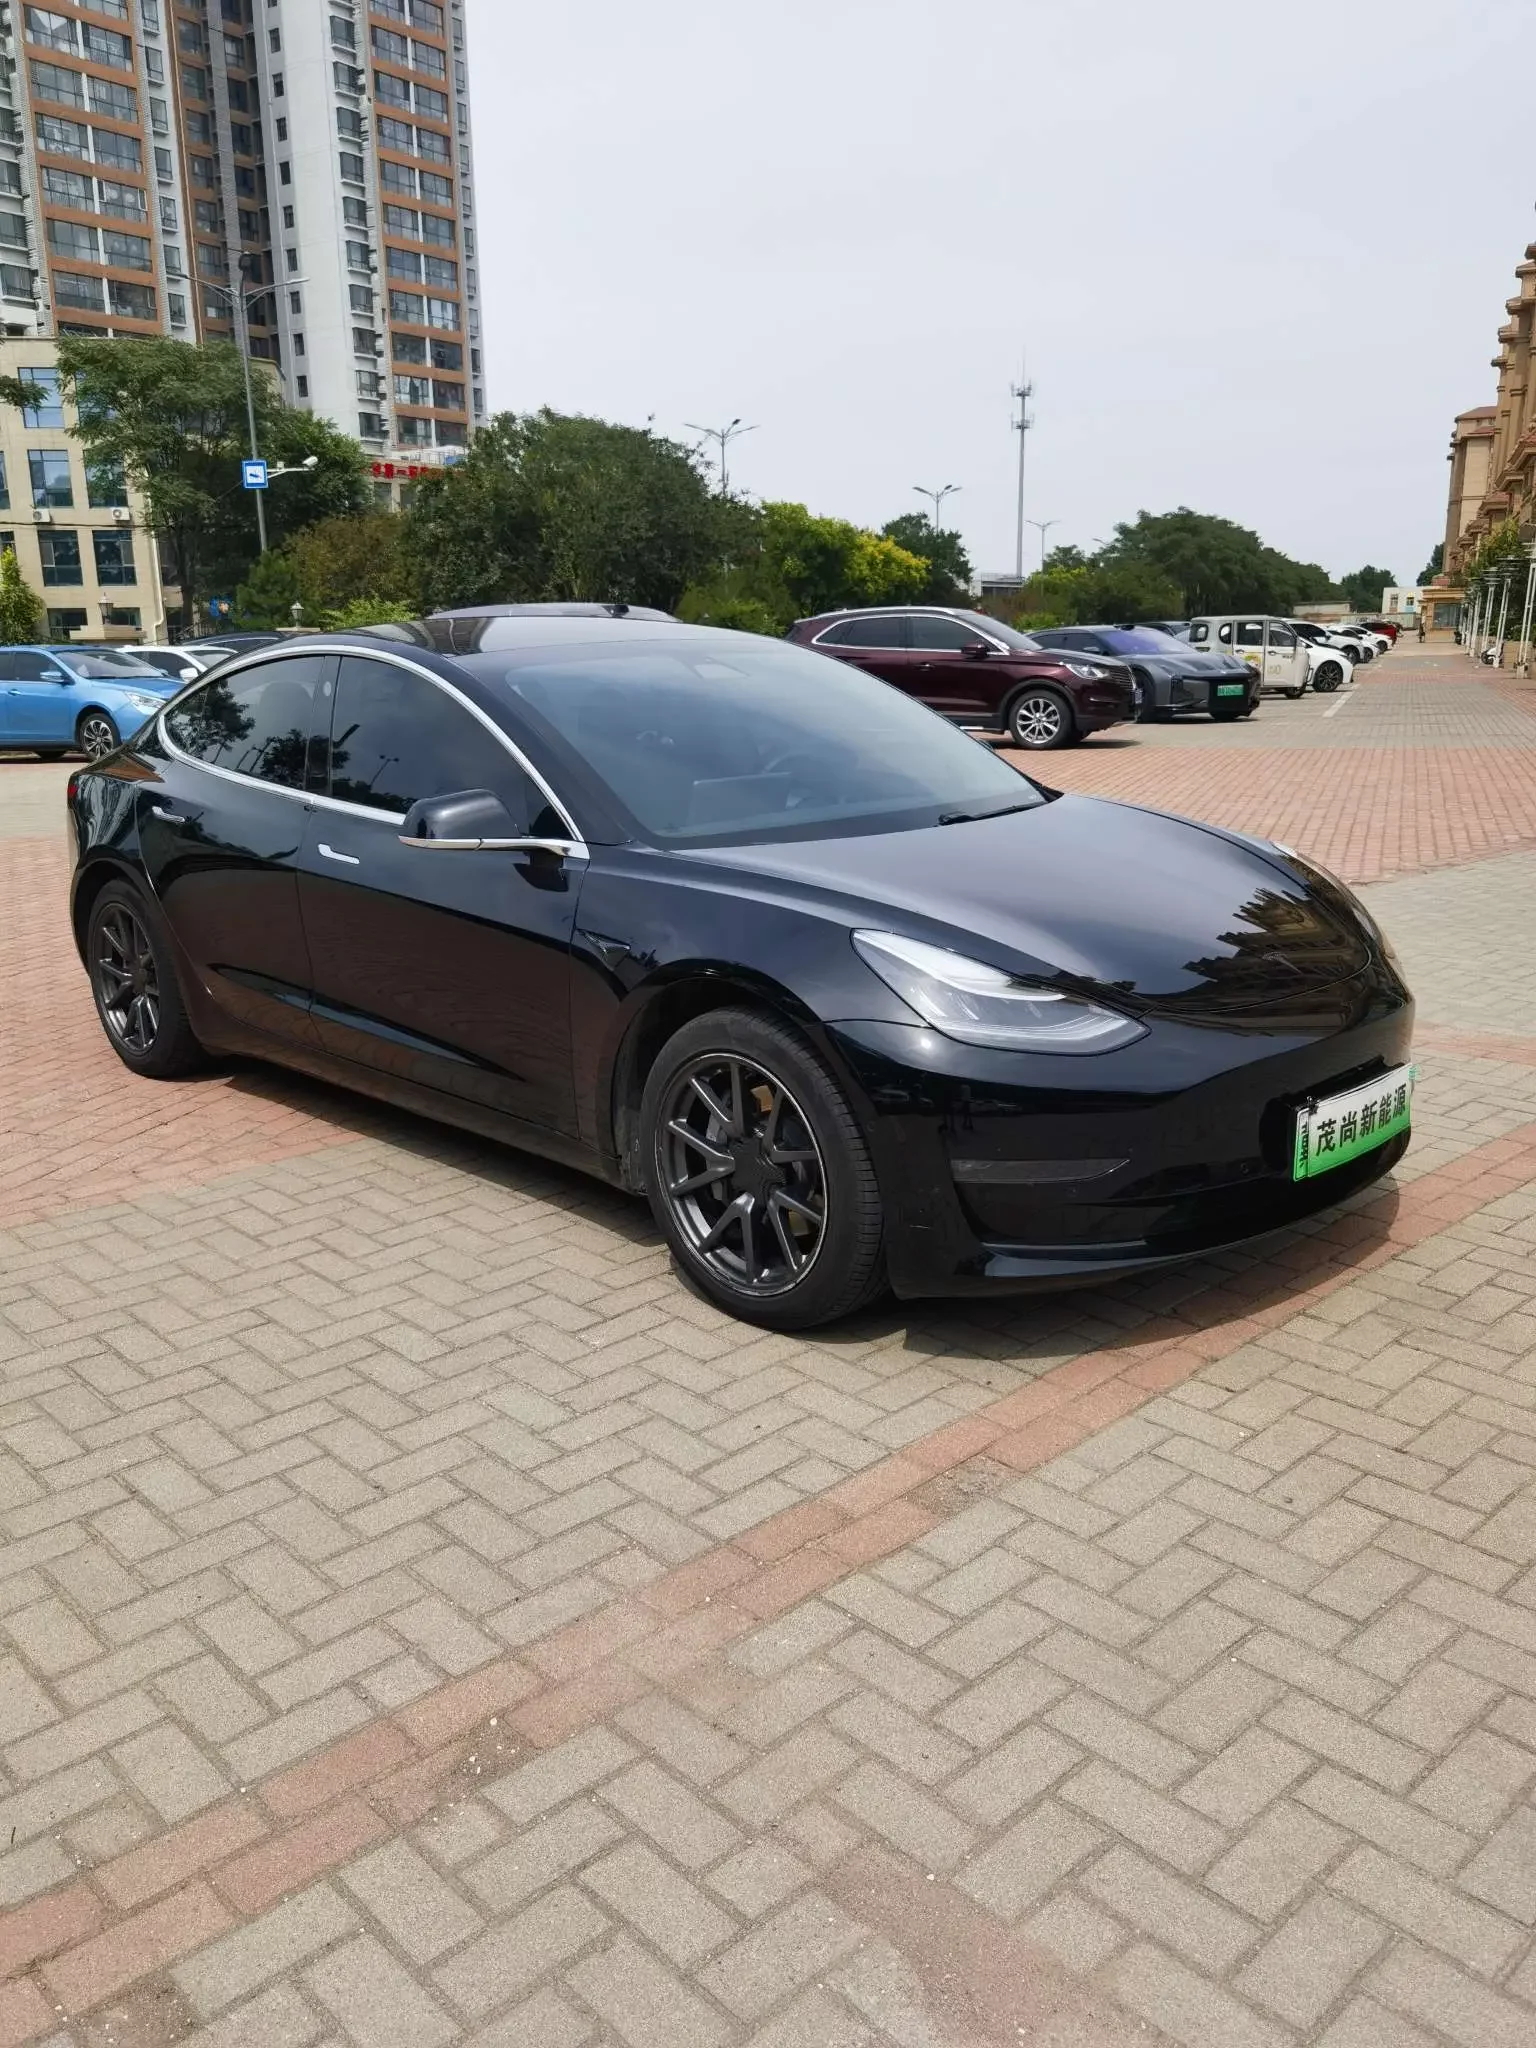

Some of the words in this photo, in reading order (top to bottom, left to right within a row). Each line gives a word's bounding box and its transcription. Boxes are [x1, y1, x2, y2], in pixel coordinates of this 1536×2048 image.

[1316, 1083, 1407, 1156] 茂尚新能源
